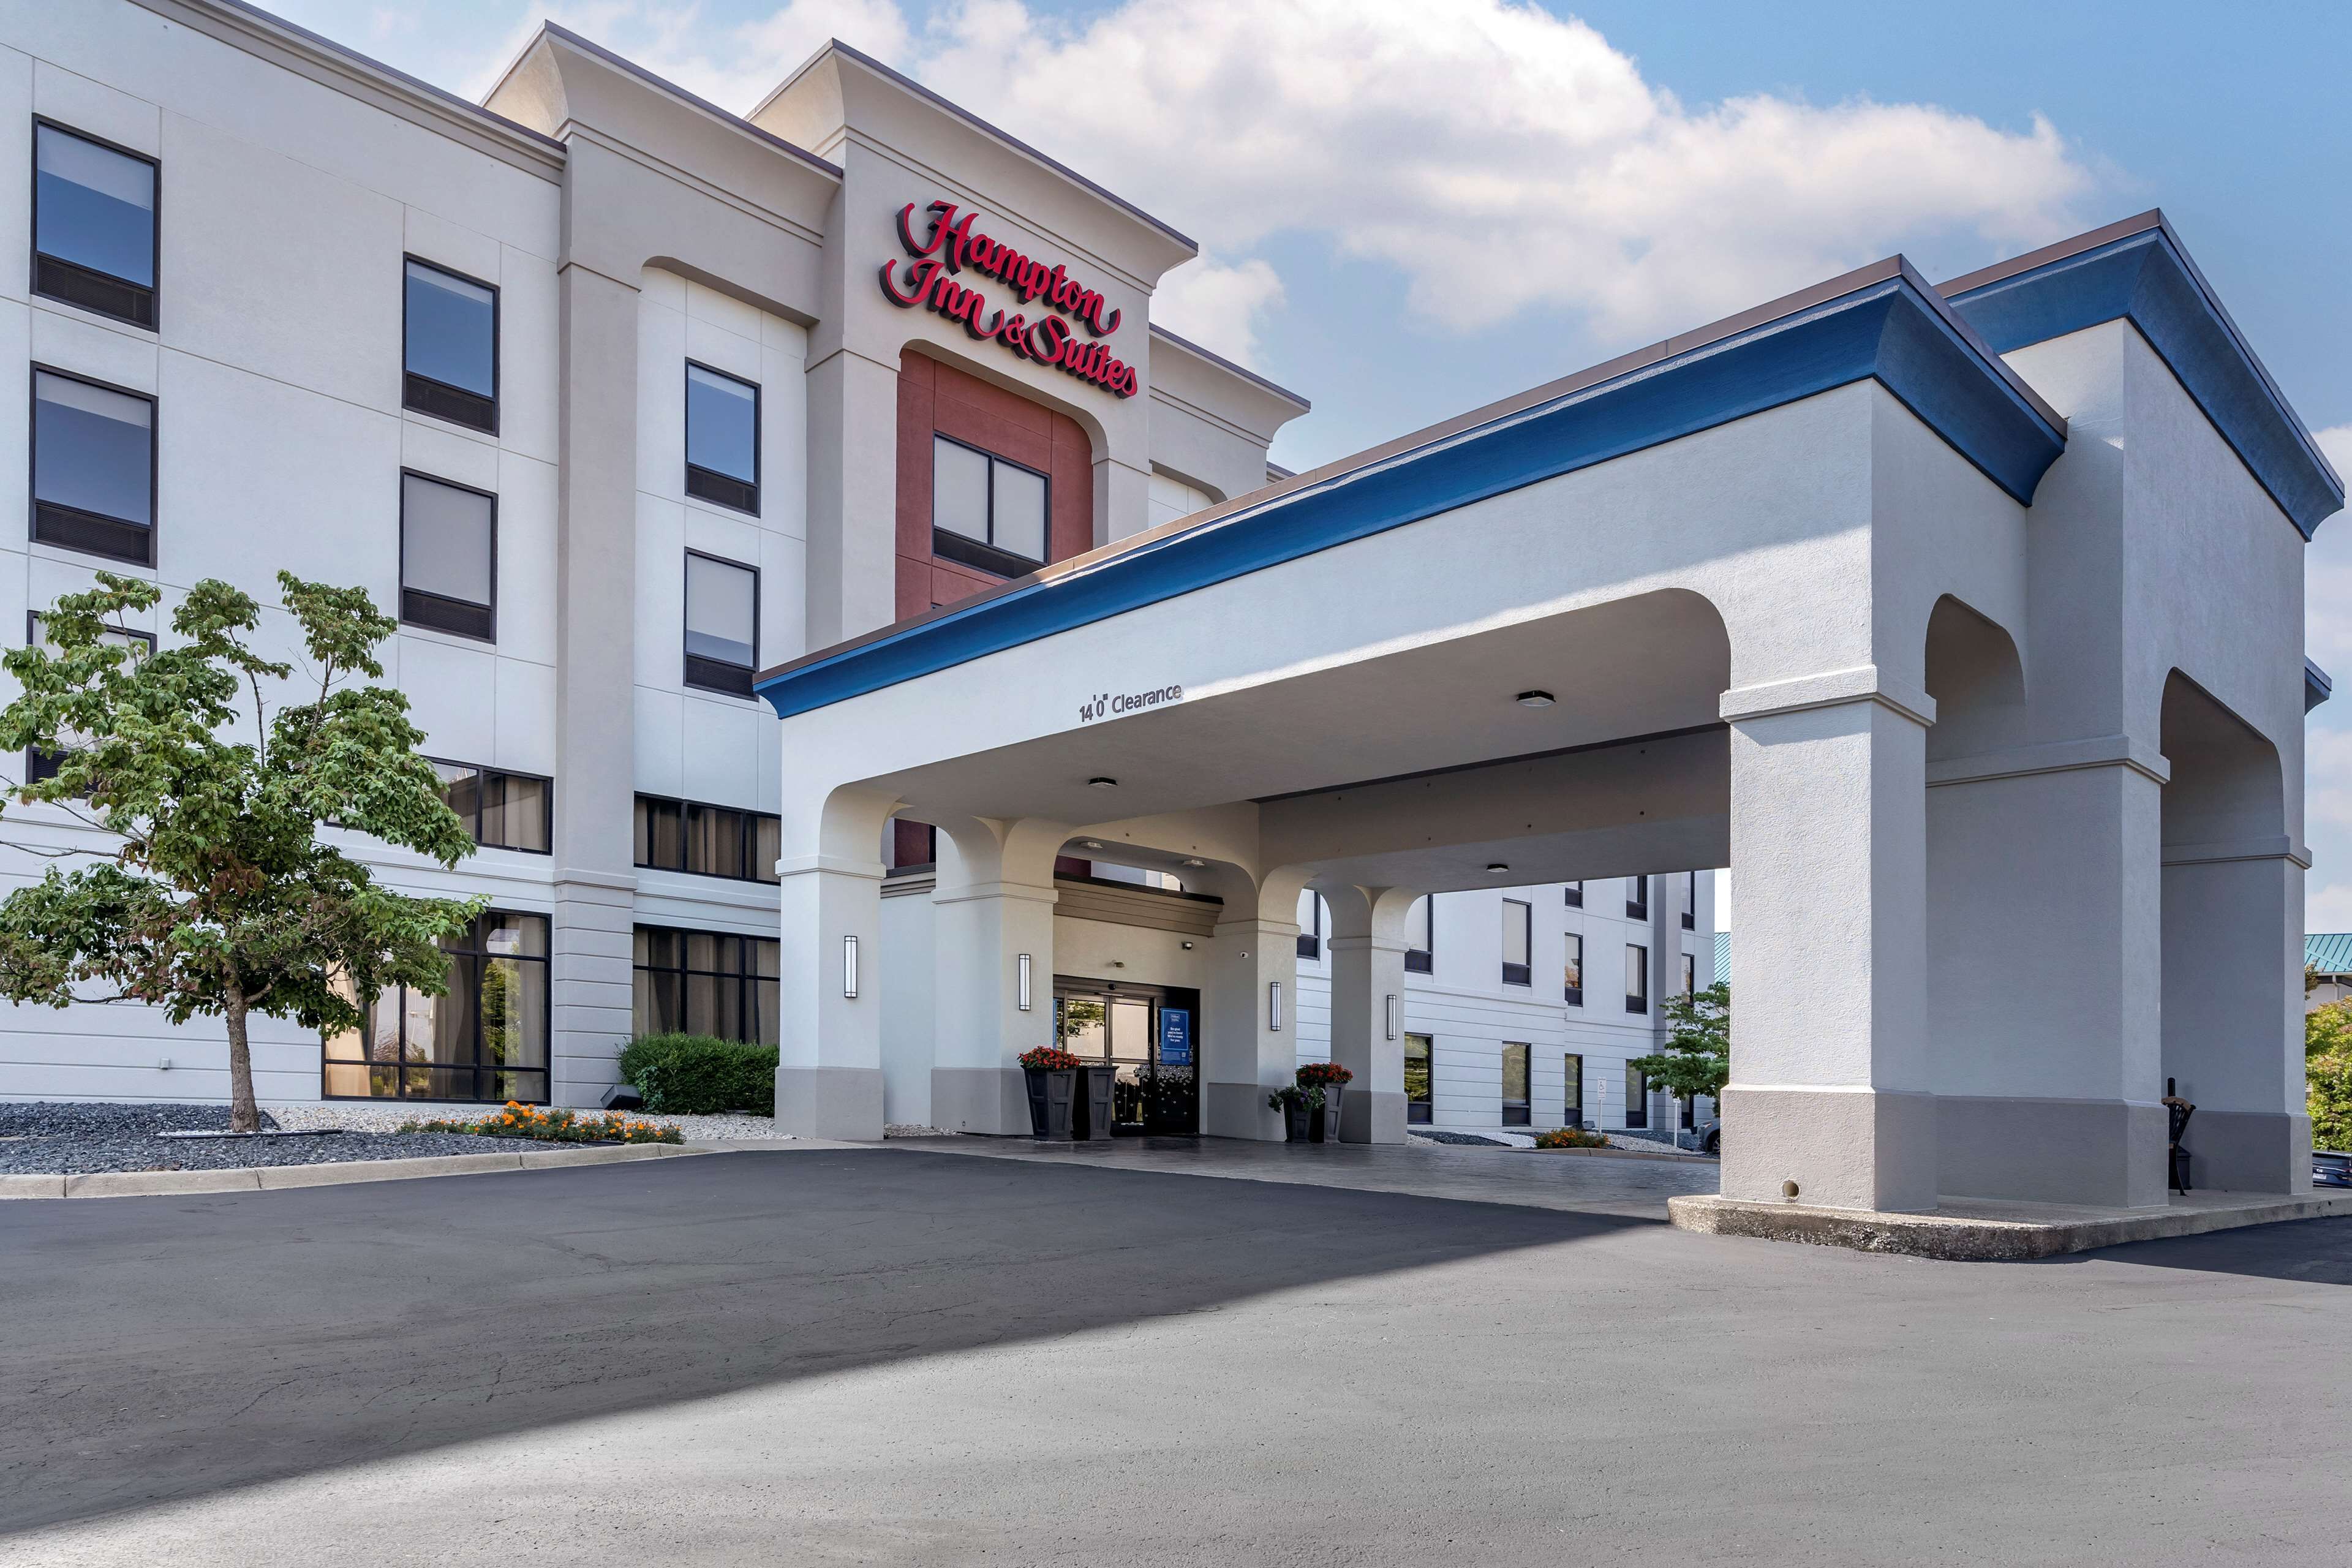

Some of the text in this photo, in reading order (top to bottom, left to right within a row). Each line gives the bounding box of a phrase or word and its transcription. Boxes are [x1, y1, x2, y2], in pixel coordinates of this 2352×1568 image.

[879, 258, 1138, 400] Inn & Suites
[896, 200, 1121, 337] Hampton
[1112, 685, 1182, 713] Clearance
